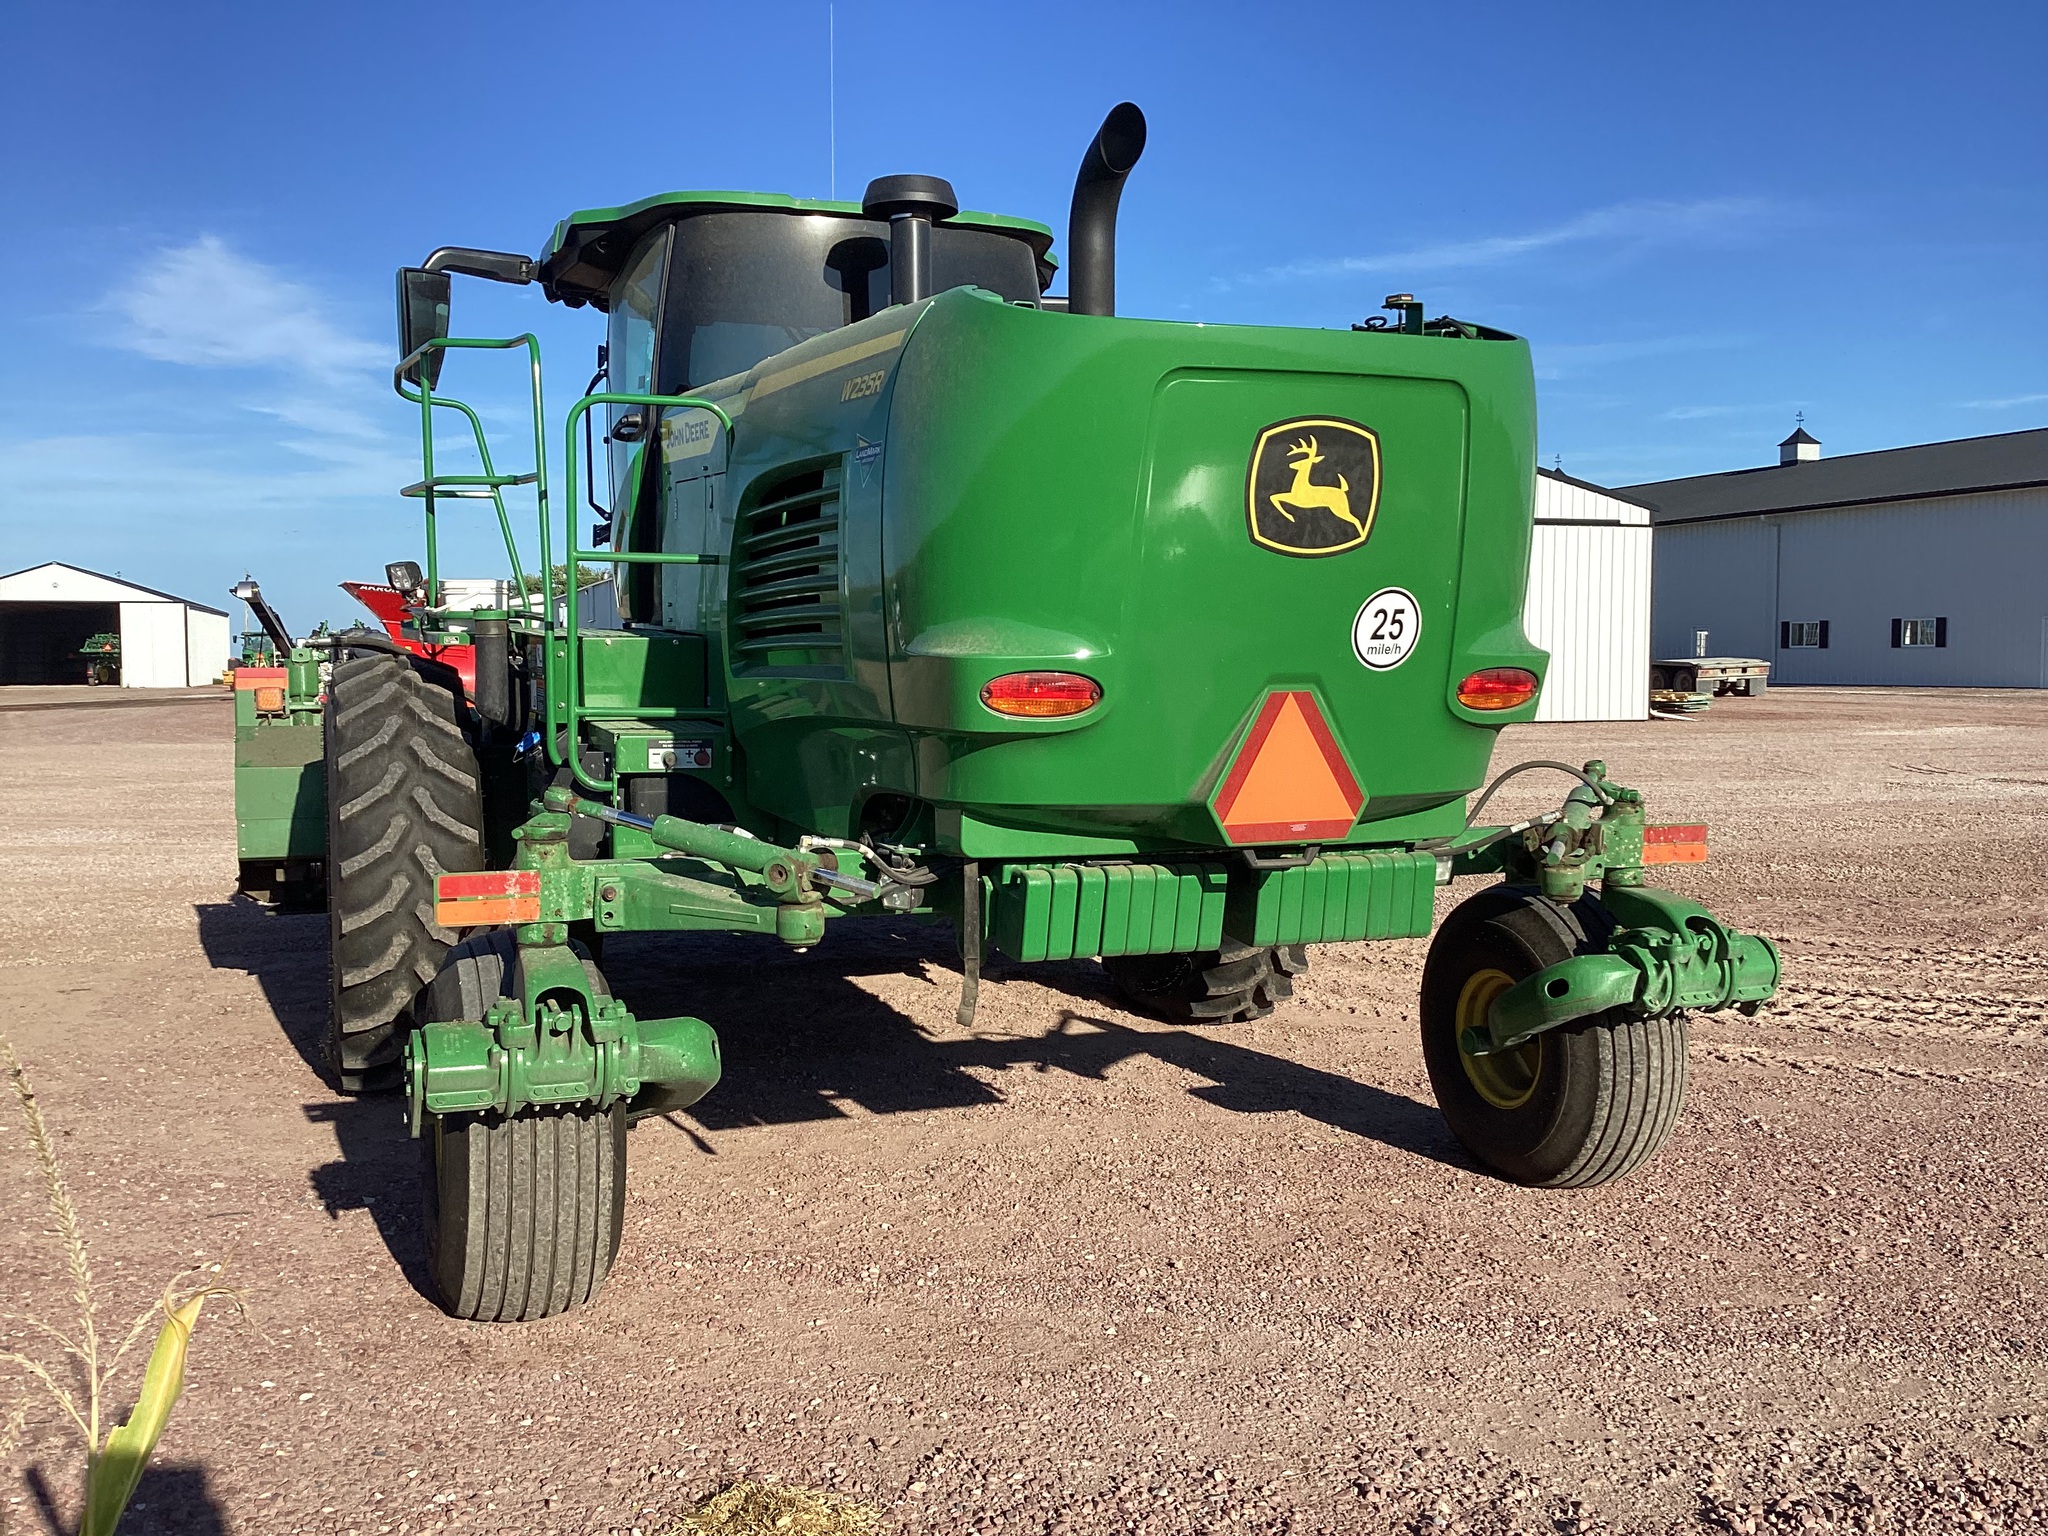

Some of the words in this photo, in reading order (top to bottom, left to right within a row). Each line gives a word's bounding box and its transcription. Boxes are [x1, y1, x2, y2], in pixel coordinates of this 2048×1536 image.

[840, 370, 885, 402] W235R
[666, 427, 685, 449] JOHN
[684, 420, 710, 444] DEERE
[1370, 608, 1405, 640] 25
[1366, 643, 1402, 655] mile/h
